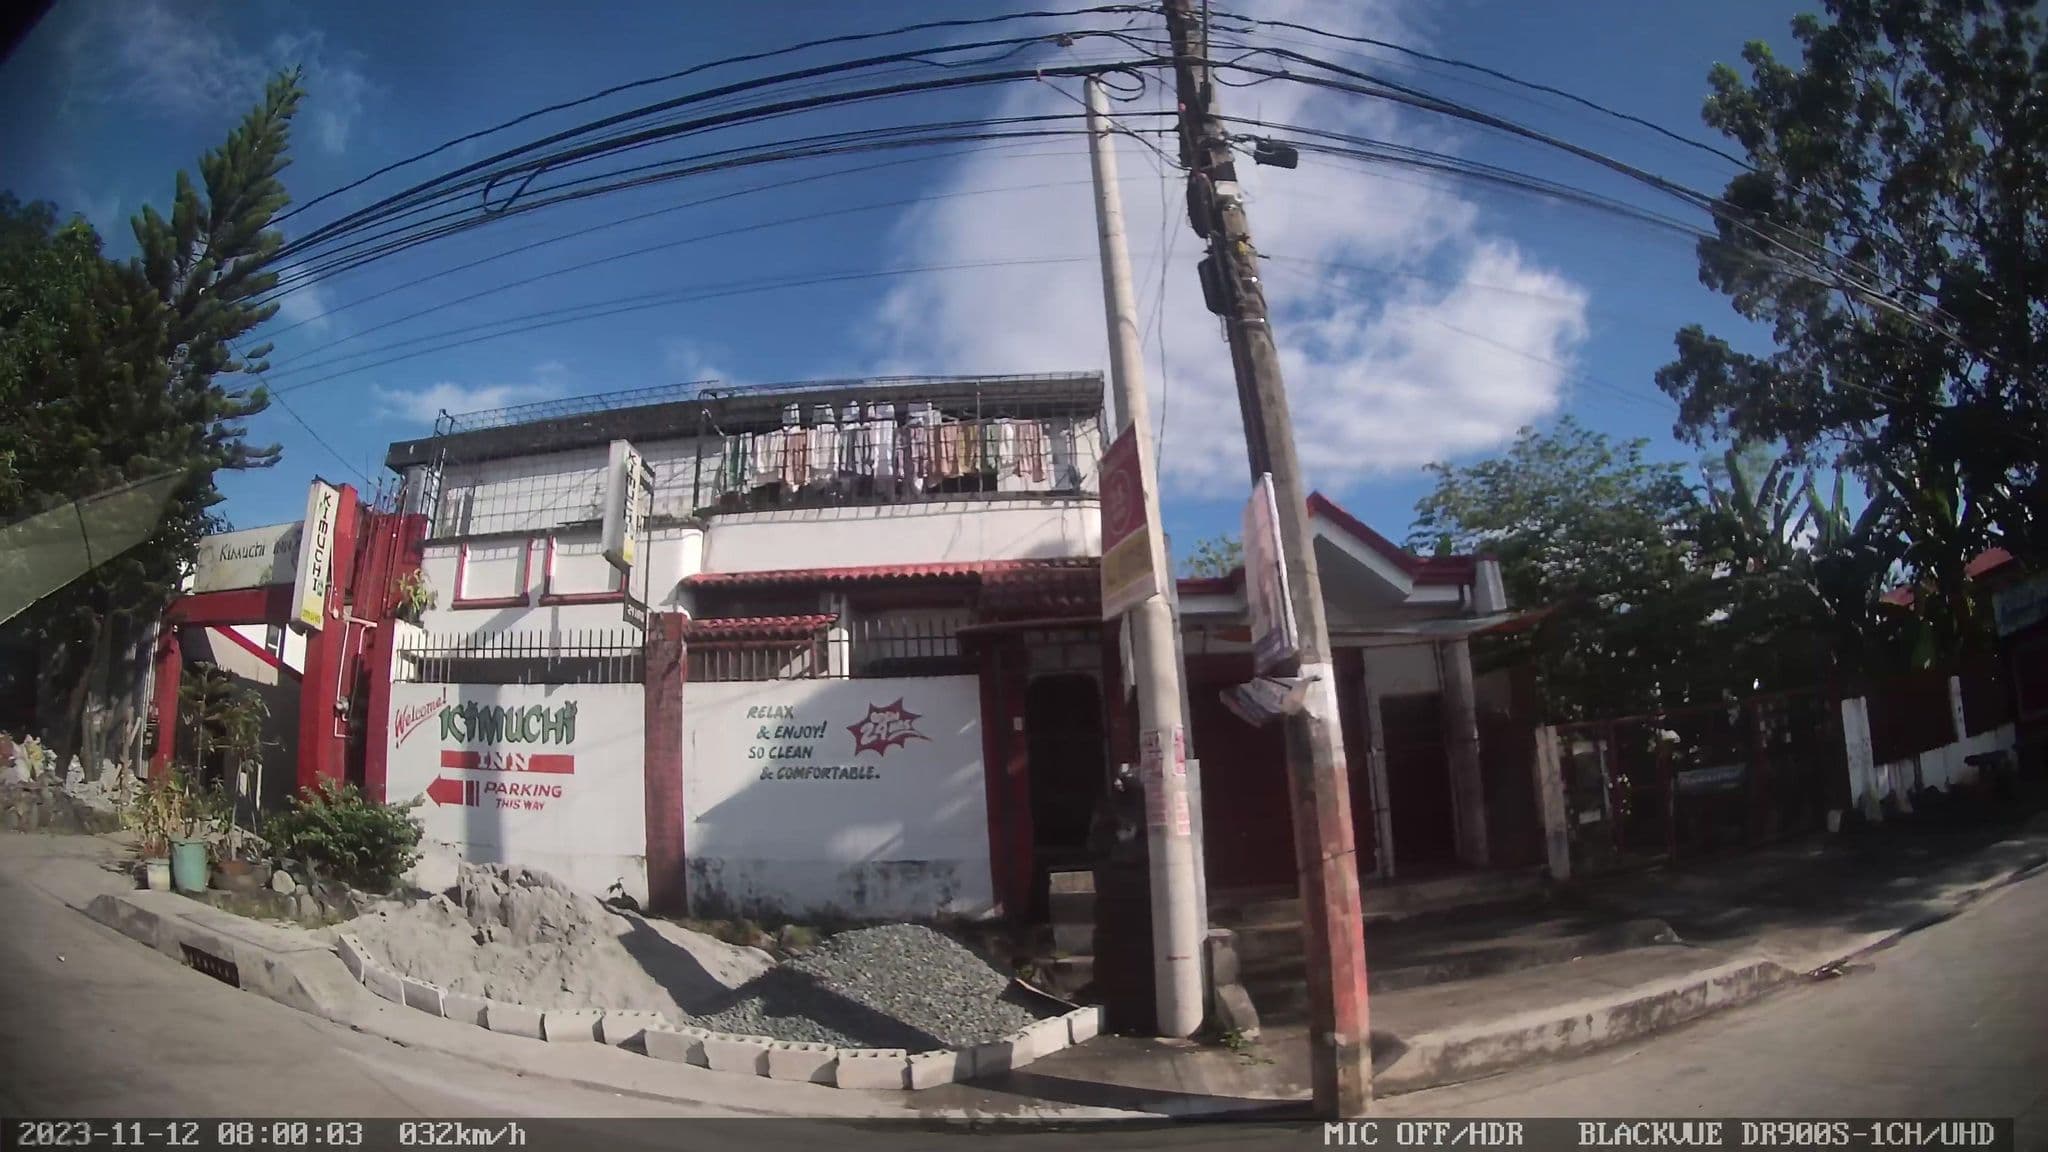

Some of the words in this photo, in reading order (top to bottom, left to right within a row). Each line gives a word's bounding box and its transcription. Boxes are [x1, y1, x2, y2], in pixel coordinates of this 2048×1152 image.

[312, 491, 332, 592] KIMUCHI
[747, 705, 794, 719] RELAX
[757, 725, 770, 740] &
[774, 720, 828, 740] ENJOY!
[860, 719, 888, 746] 24
[477, 751, 530, 771] INN
[748, 746, 765, 759] SO
[768, 746, 814, 760] CLEAN
[760, 766, 774, 781] &
[776, 766, 880, 780] COMFORTABLE.
[484, 780, 562, 798] PARKING
[495, 799, 521, 811] THIS
[523, 799, 545, 811] WAY
